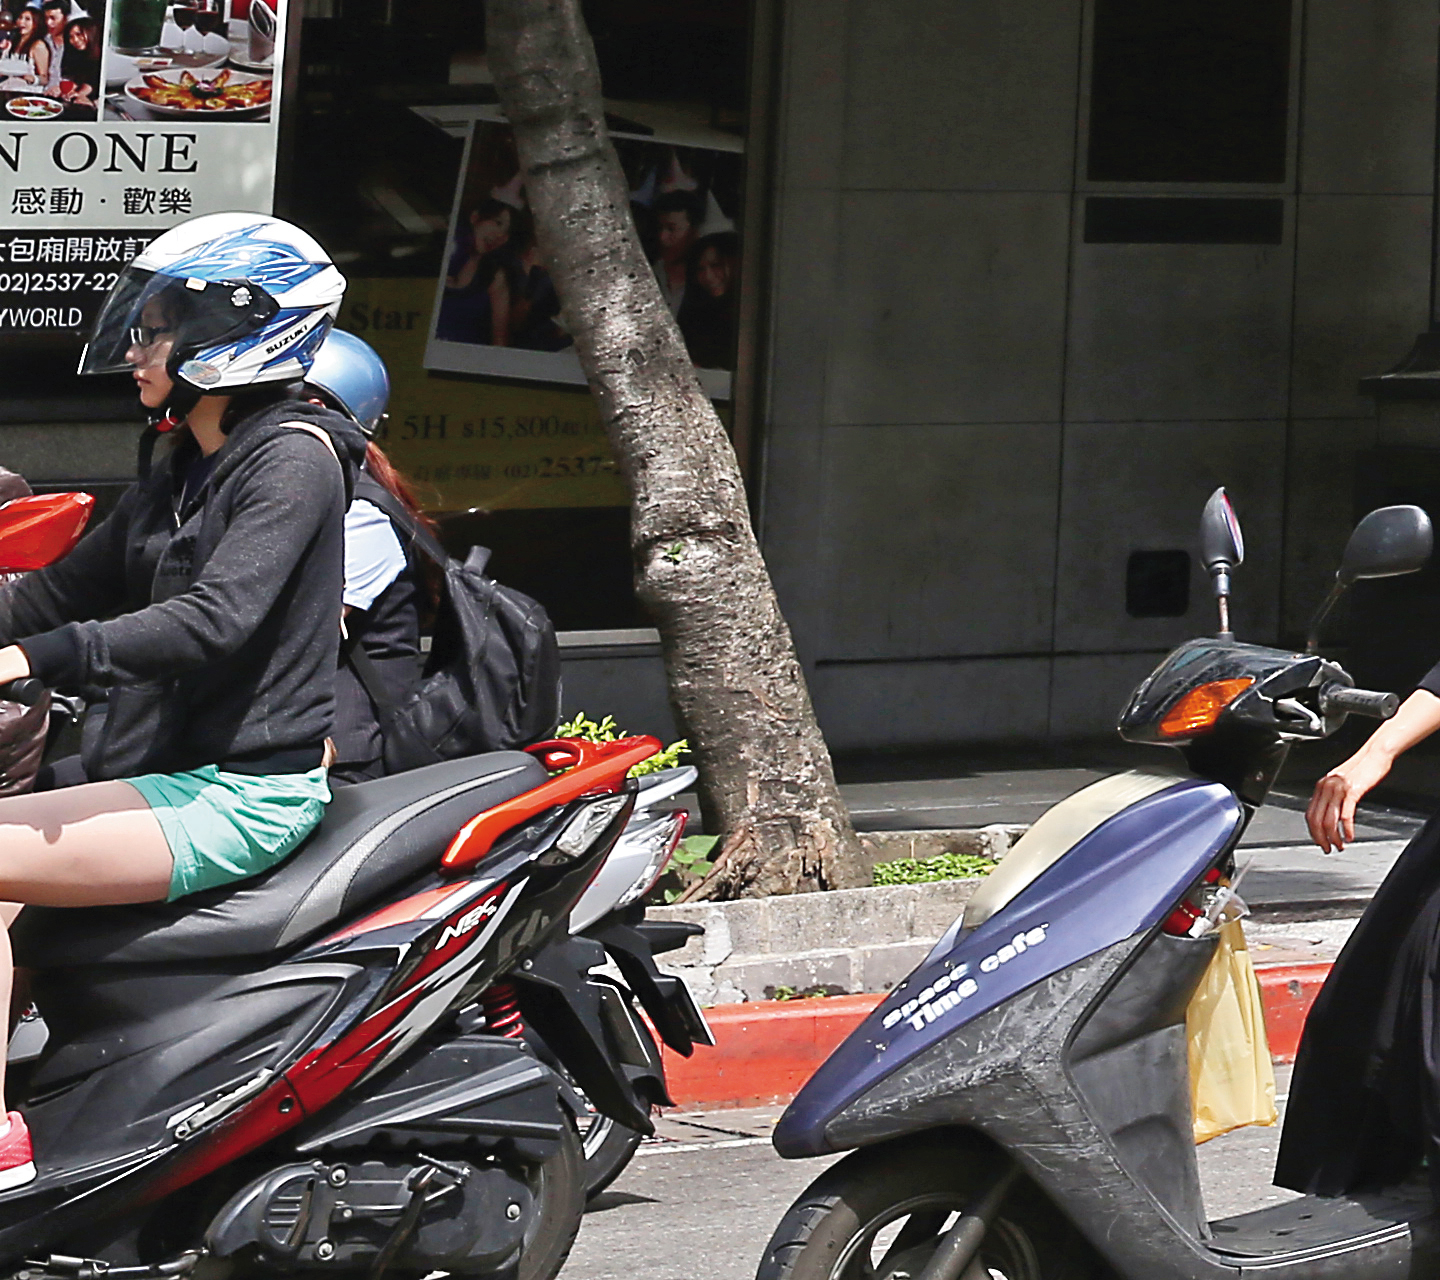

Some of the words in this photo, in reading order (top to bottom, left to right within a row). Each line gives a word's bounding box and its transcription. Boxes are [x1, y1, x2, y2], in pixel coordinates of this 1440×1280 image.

[52, 131, 198, 174] ONE
[349, 302, 422, 331] Star
[265, 324, 309, 355] SUZUKI
